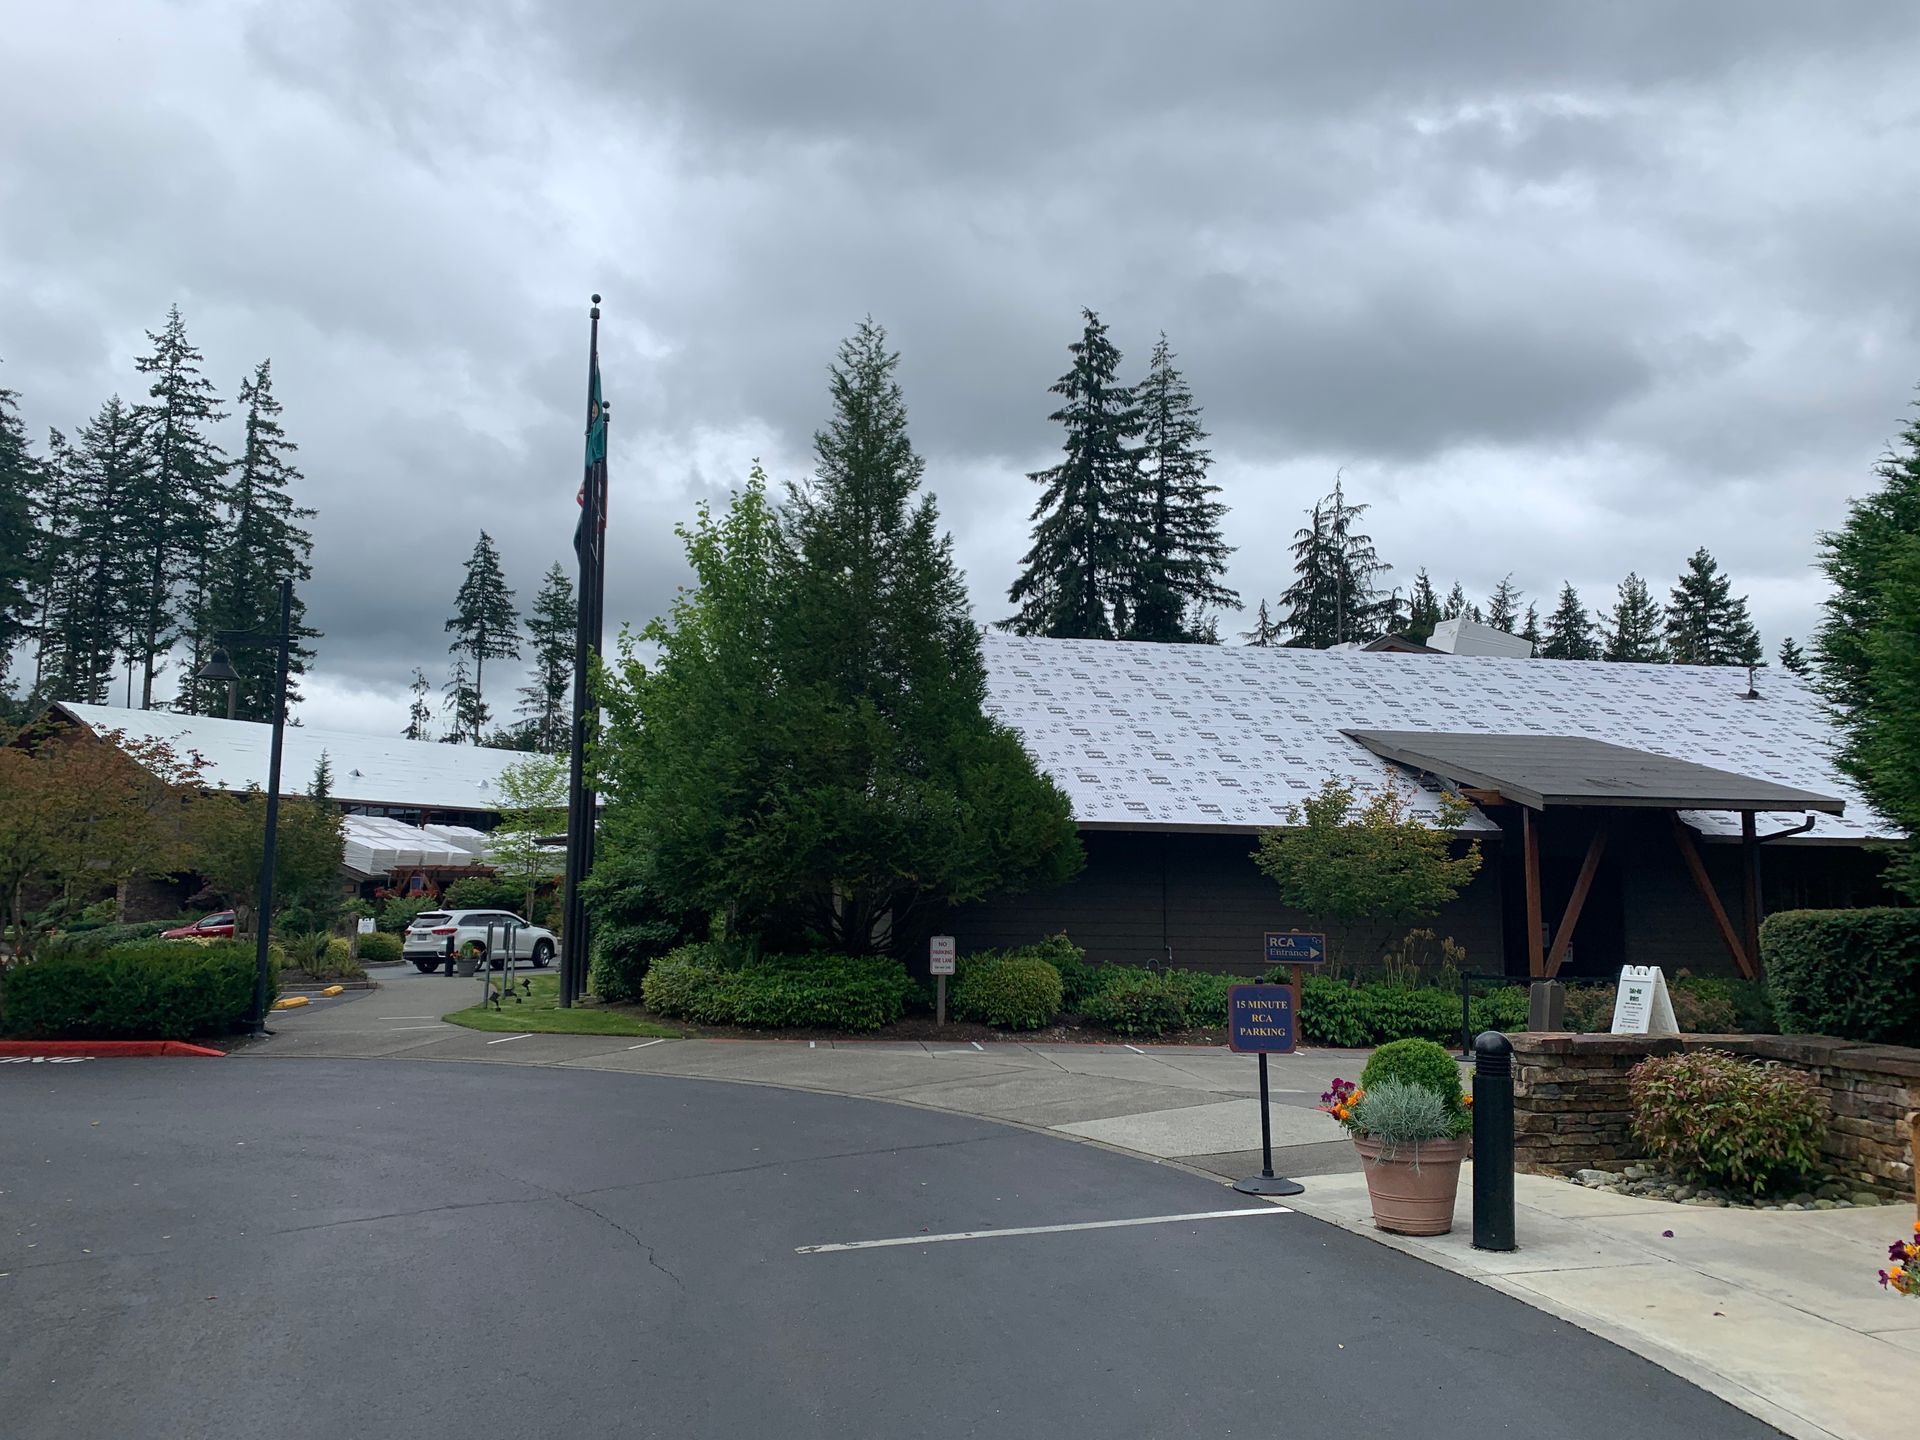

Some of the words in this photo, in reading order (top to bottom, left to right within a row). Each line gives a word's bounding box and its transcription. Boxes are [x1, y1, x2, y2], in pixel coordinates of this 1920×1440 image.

[1269, 937, 1295, 947] RCA
[1270, 948, 1309, 957] Entrance
[1236, 1000, 1246, 1009] 15
[1248, 1000, 1288, 1010] MINUTE
[1251, 1014, 1273, 1023] RCA
[1239, 1027, 1286, 1037] PARKING
